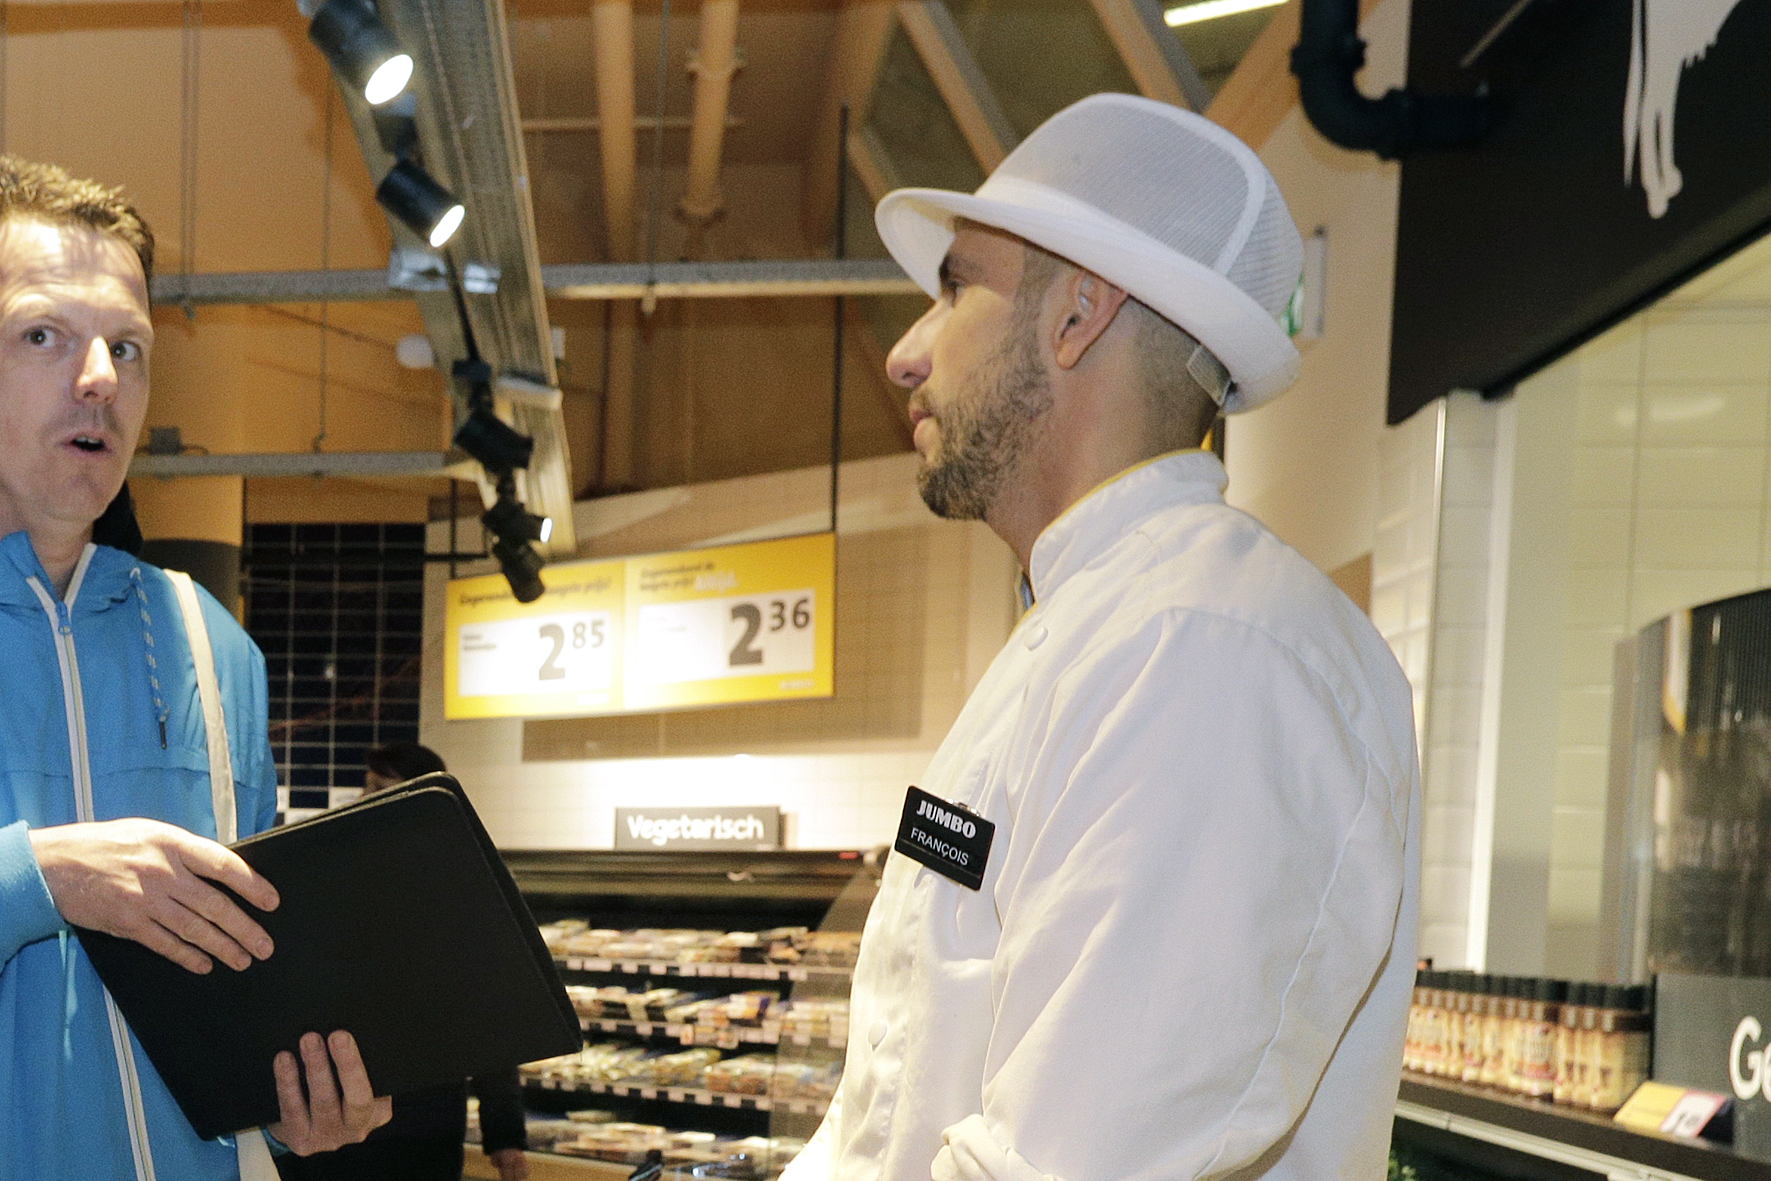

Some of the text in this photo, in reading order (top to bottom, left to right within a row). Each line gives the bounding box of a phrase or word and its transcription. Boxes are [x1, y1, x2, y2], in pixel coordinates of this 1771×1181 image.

[627, 814, 765, 846] Vegetarisch
[916, 800, 976, 838] JUMBO
[910, 827, 969, 866] FRANÇOIS
